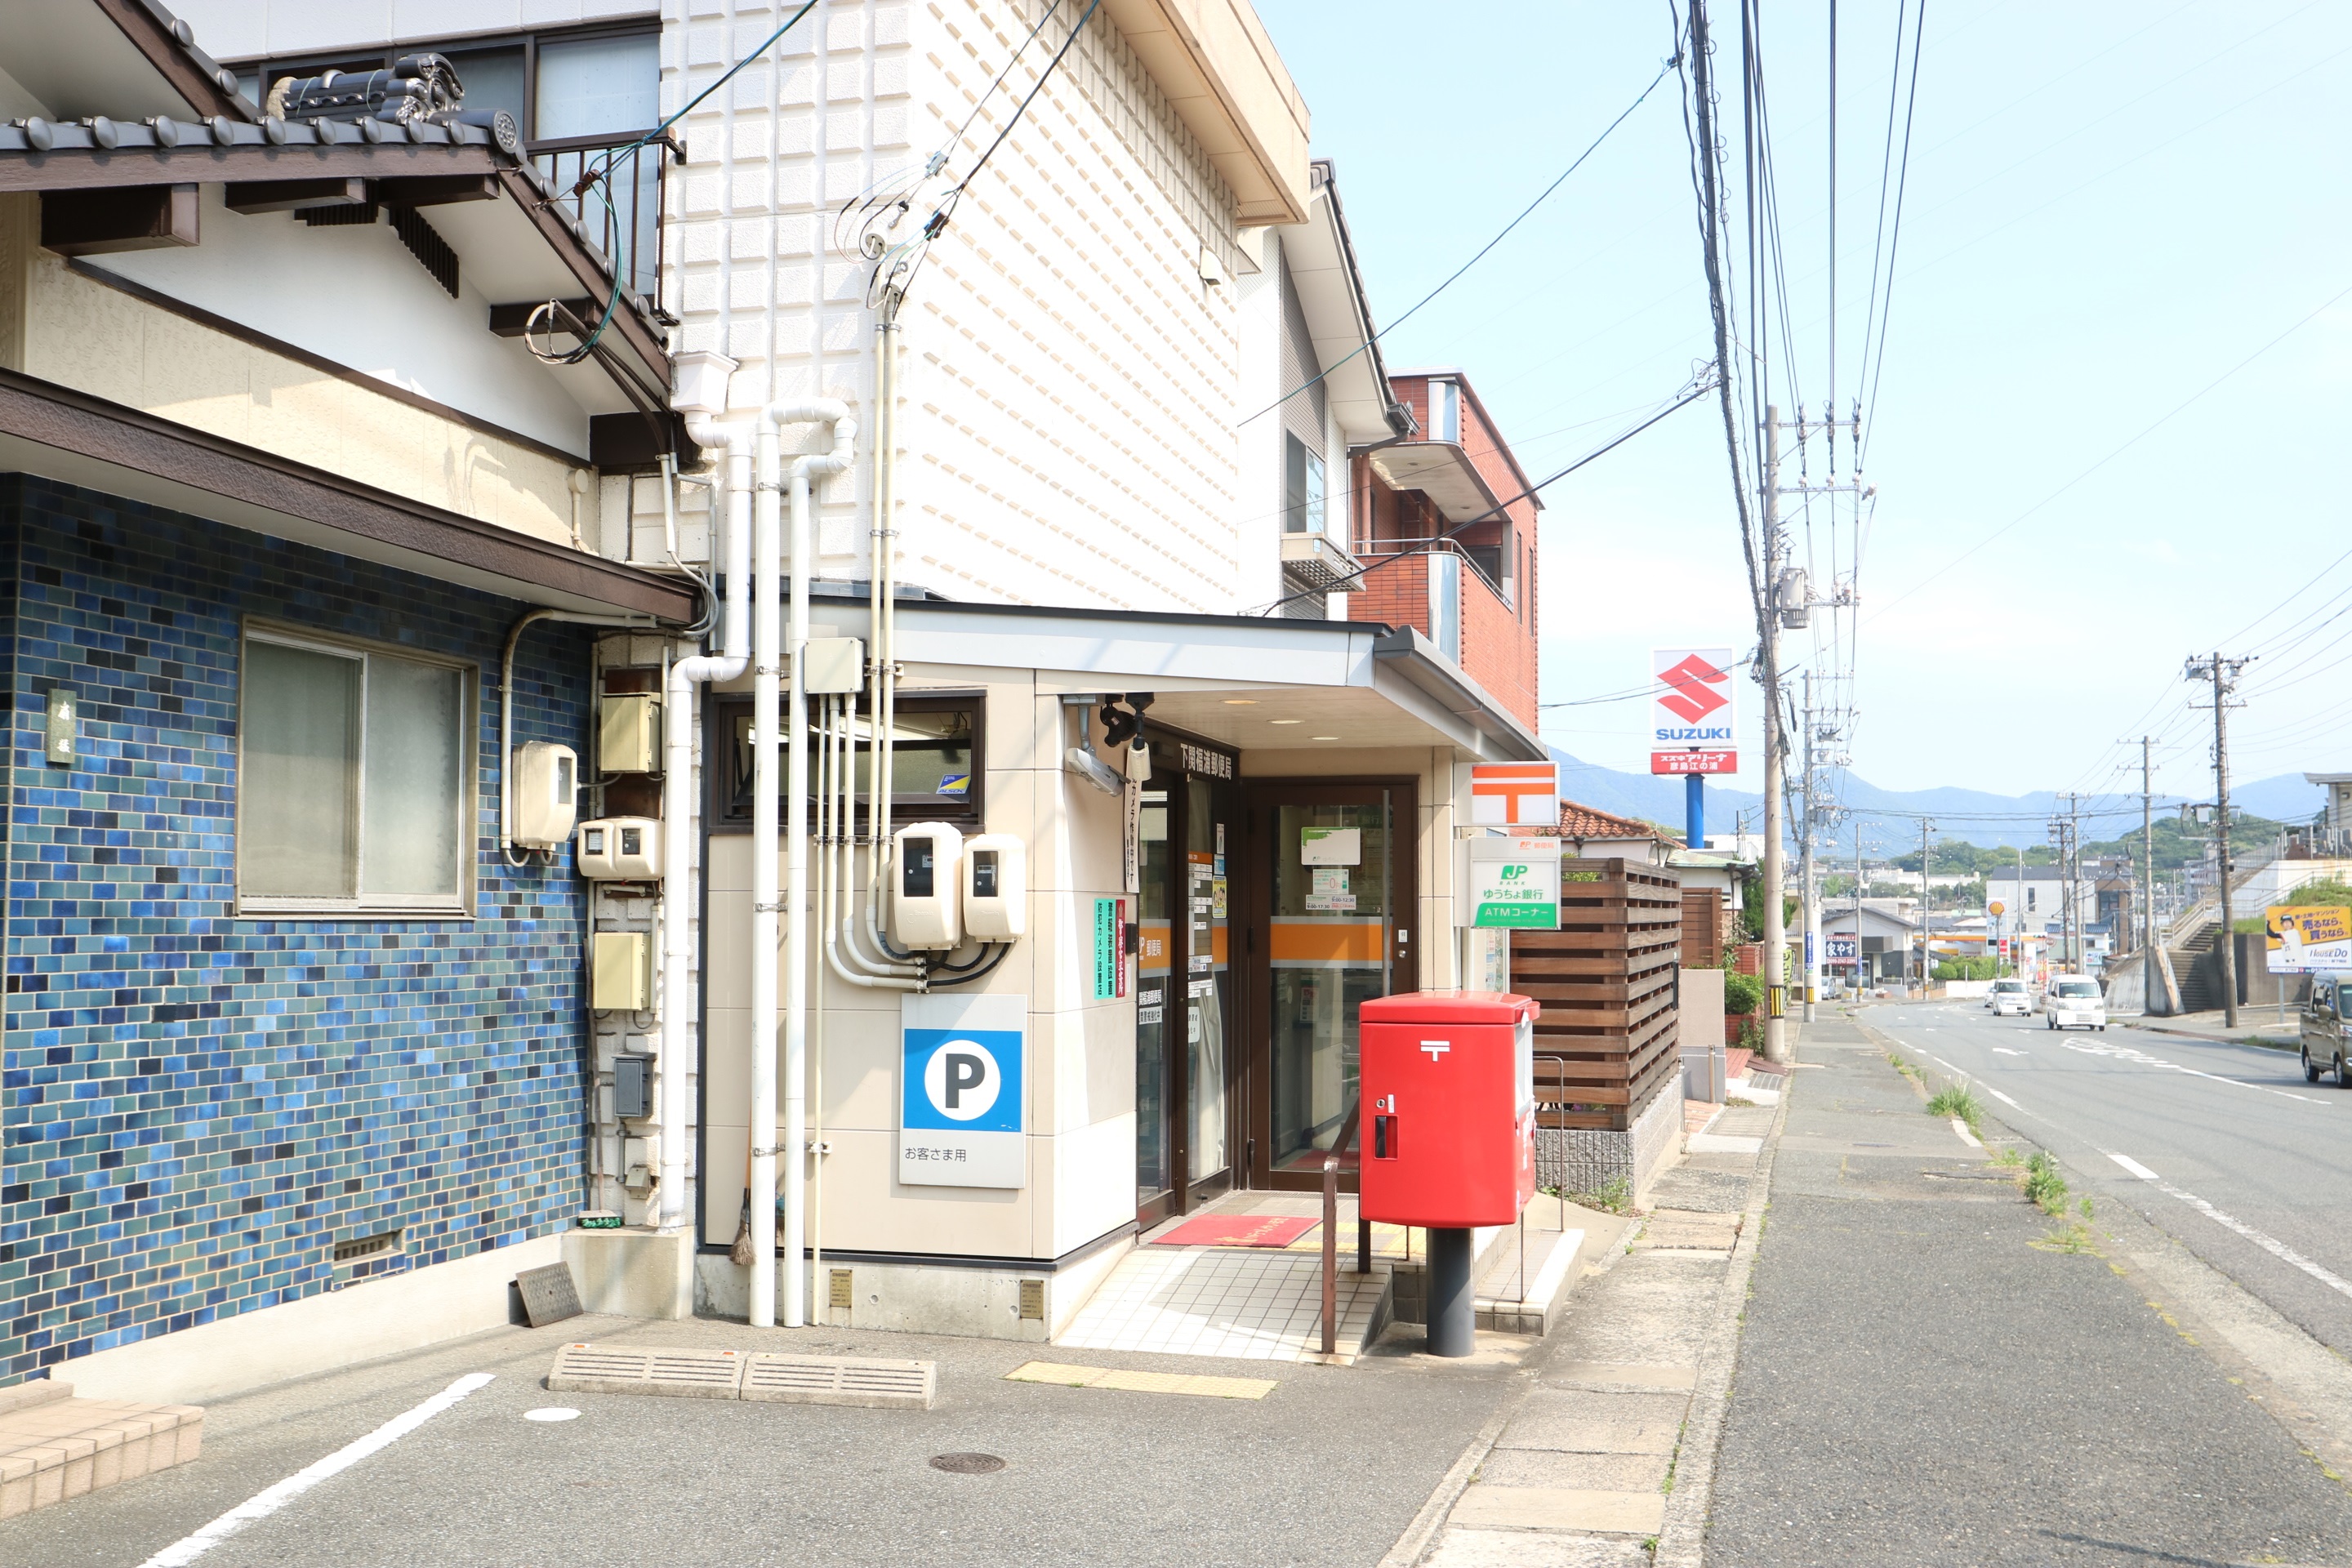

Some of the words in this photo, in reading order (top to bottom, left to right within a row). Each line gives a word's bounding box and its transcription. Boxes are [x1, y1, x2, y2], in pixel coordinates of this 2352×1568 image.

[1655, 728, 1731, 740] SUZUKI
[1180, 742, 1232, 781] 下関福浦郵便局
[1660, 753, 1727, 762] スズキアリーナ
[1669, 762, 1718, 770] 彦島江の浦
[1501, 865, 1528, 880] JP
[1483, 889, 1544, 900] ゆうちょ銀行
[1485, 907, 1549, 917] ATMコーナー
[1147, 940, 1161, 956] 郵便局
[945, 1053, 986, 1109] P
[904, 1147, 967, 1163] お客さま用
